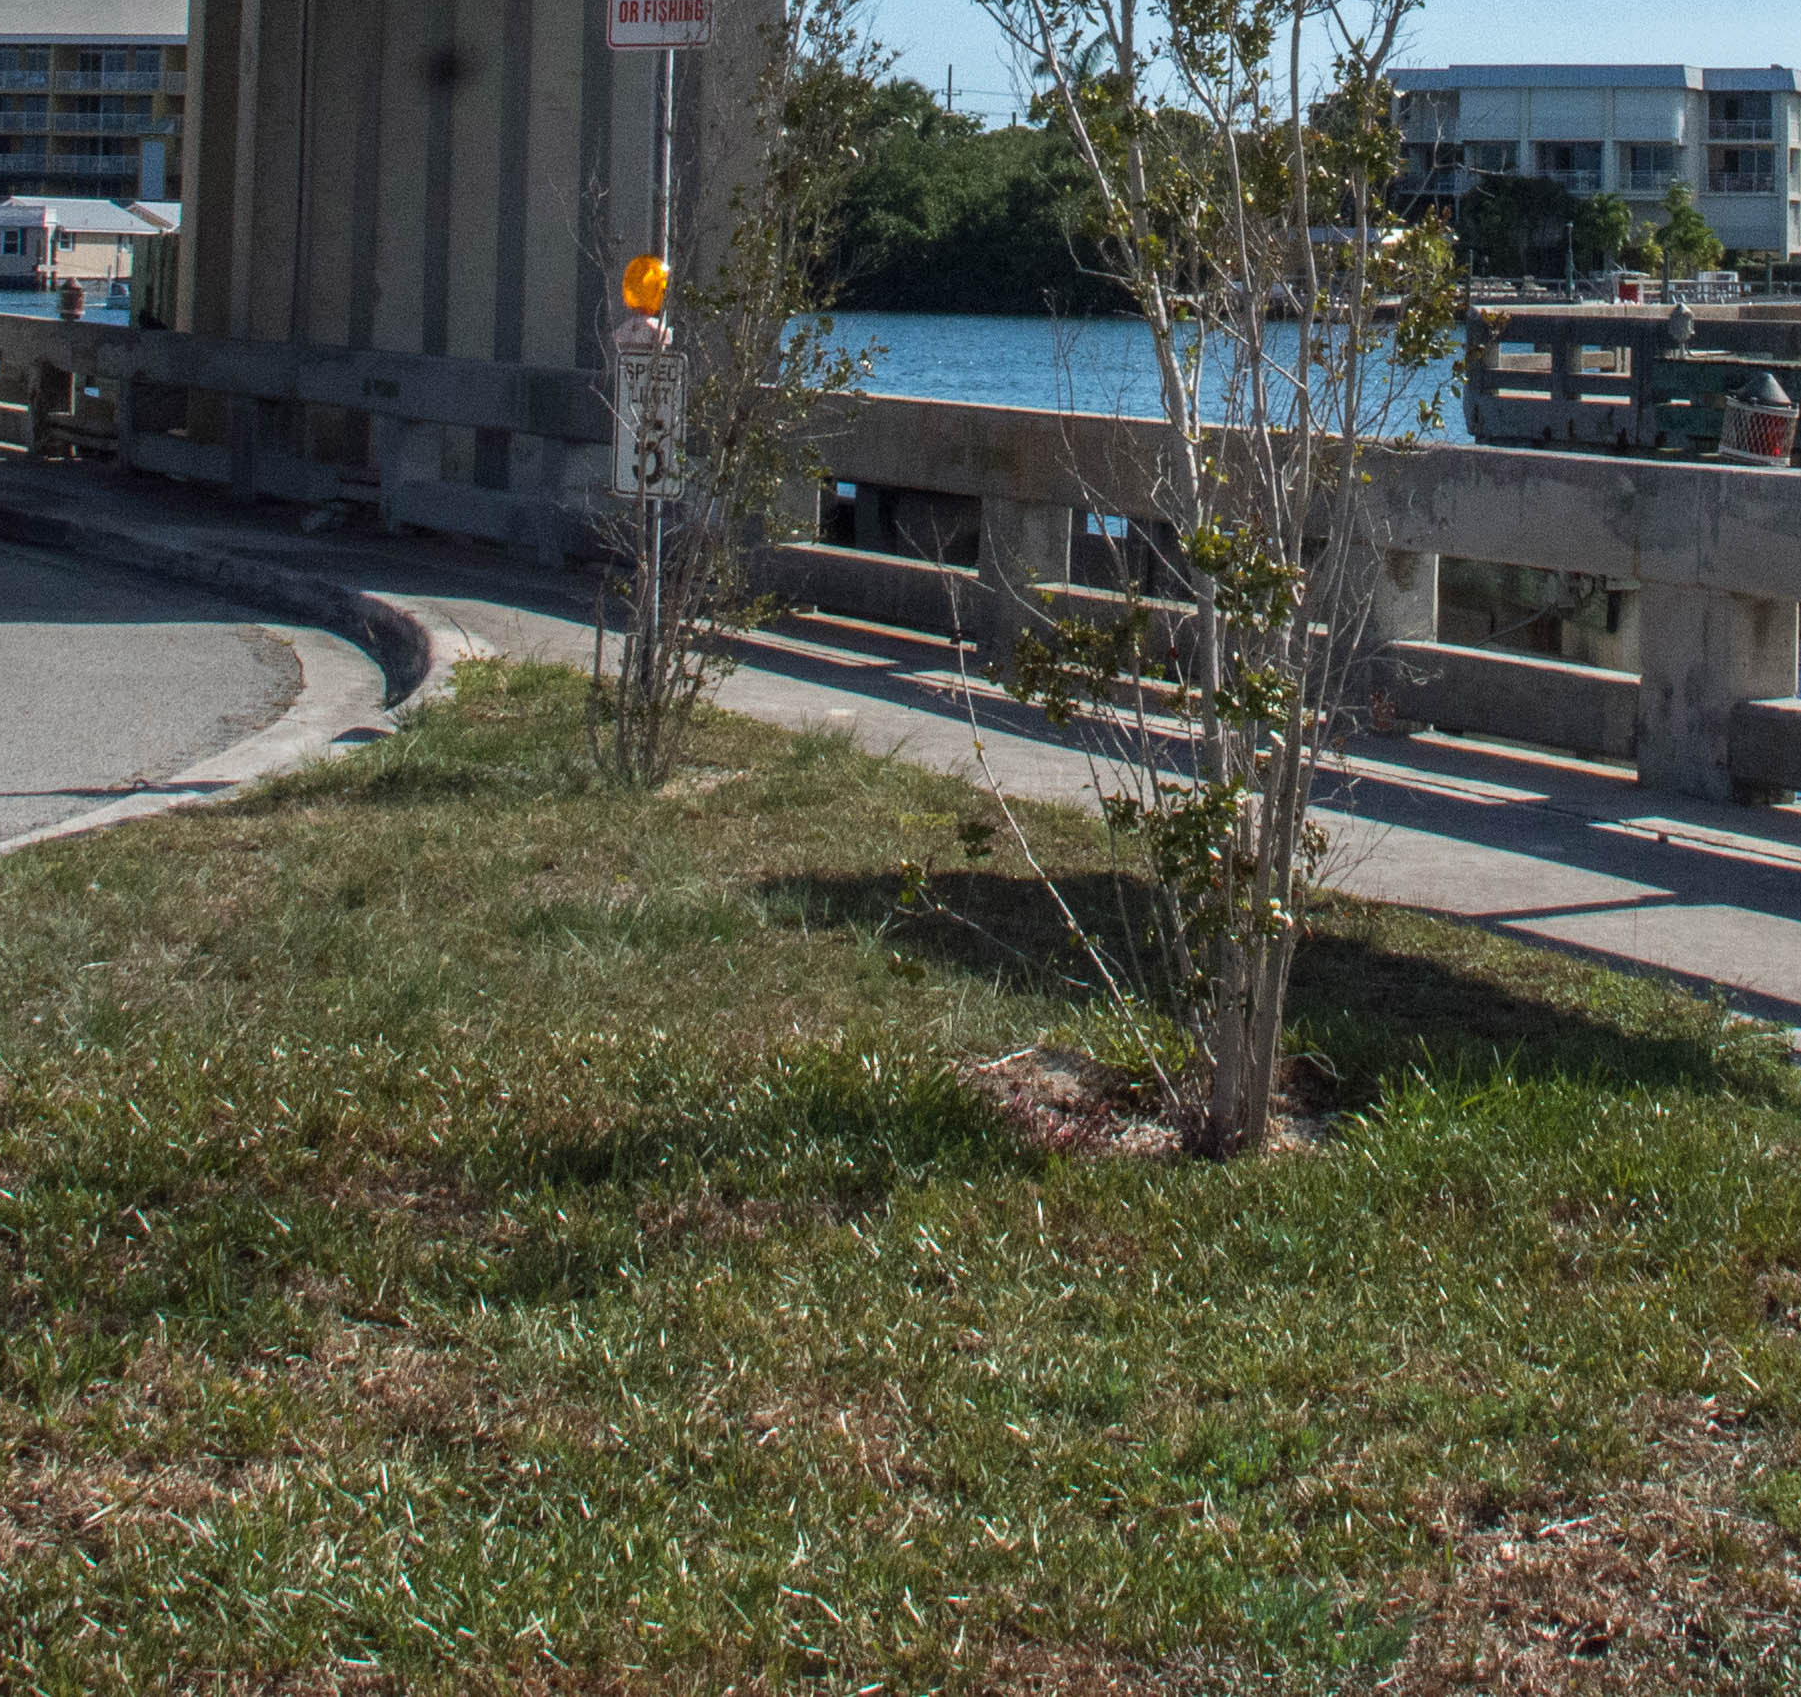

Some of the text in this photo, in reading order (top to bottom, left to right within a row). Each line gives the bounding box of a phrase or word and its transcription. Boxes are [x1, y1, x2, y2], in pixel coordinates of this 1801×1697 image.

[618, 0, 704, 24] OR FISHING
[630, 386, 672, 404] LIT
